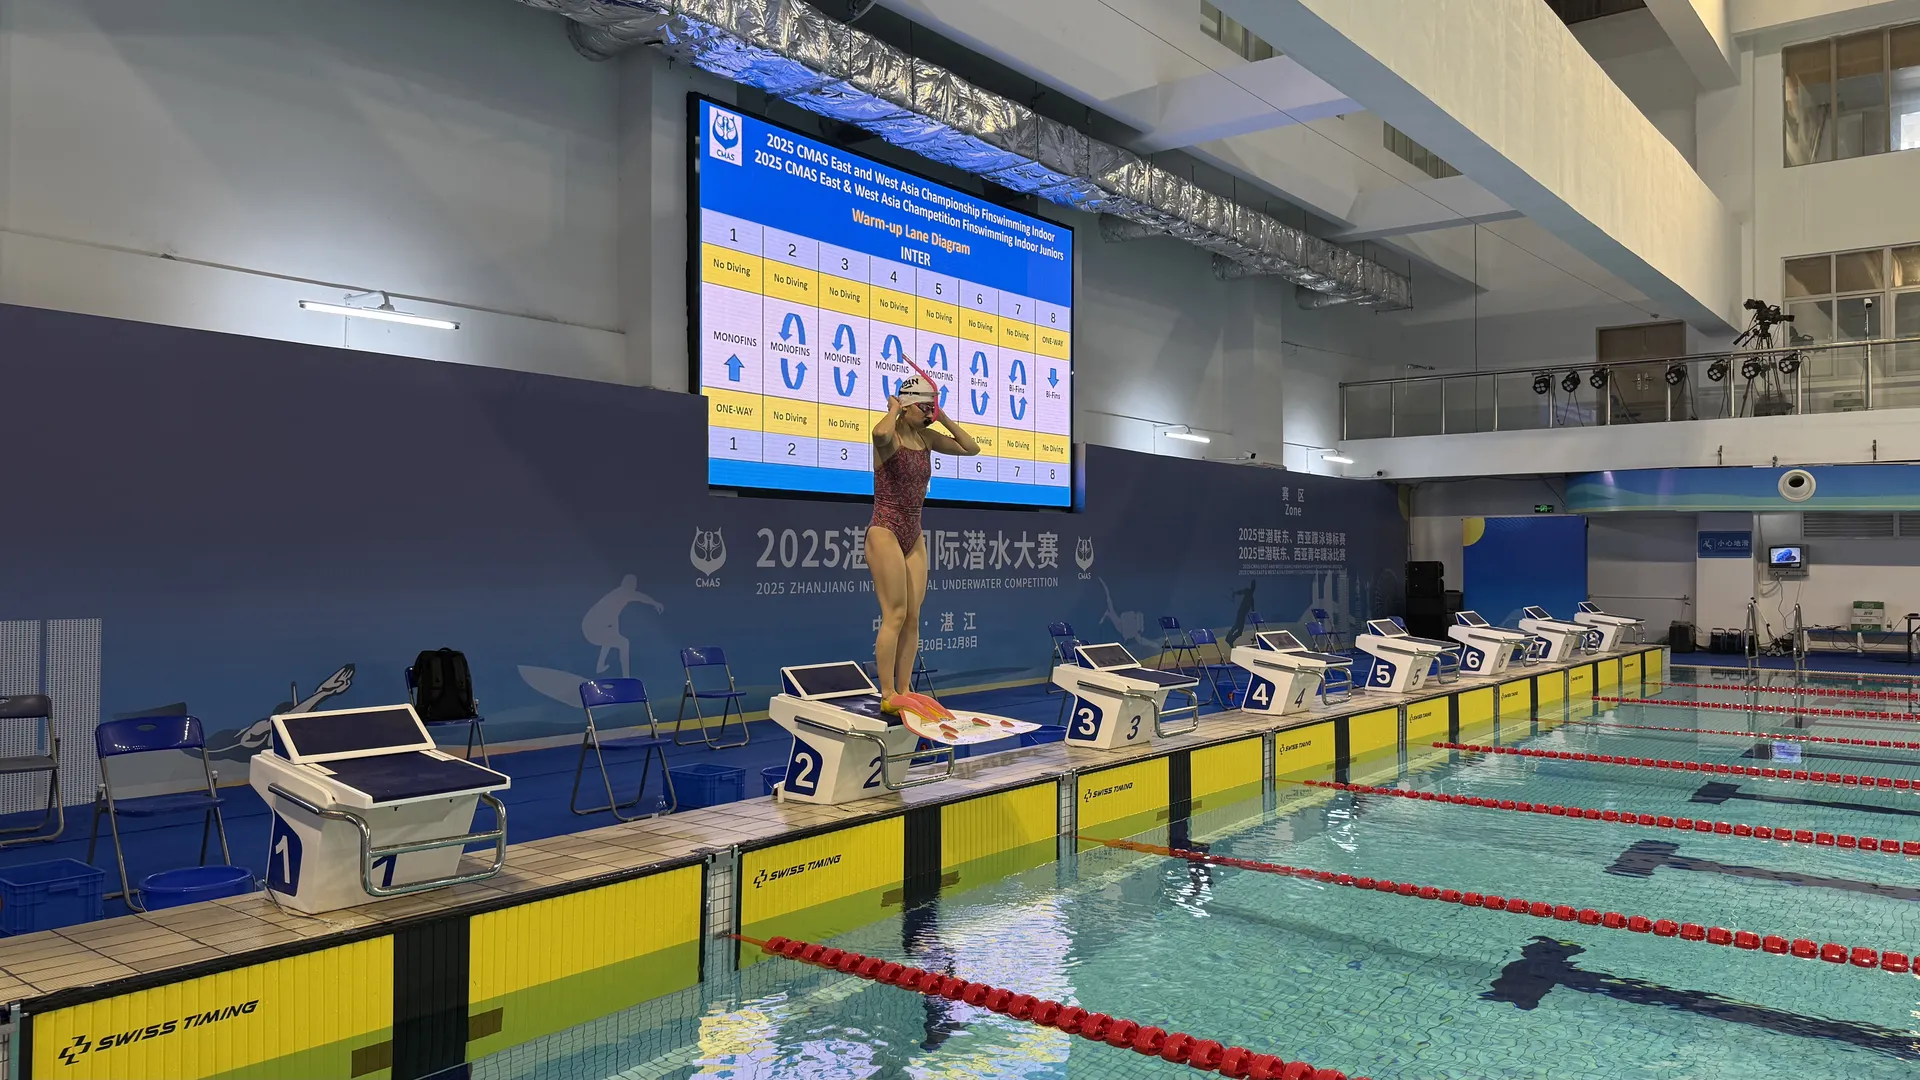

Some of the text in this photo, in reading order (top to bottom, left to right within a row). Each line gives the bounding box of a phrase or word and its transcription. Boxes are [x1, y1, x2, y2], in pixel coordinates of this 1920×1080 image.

[716, 149, 735, 161] CMAS
[766, 133, 1056, 243] 2025 CMAS East and West Asia Championship Finswimming Indoor
[754, 150, 1065, 261] 2025 CMAS East & West Asia Champetition Finswimming Indoor Juniors
[730, 228, 738, 242] 1
[852, 207, 971, 256] Warm-up Lane Diagram
[788, 243, 797, 257] 2
[901, 245, 931, 267] INTER
[713, 258, 751, 277] No Diving
[841, 258, 849, 270] 3
[774, 273, 808, 291] No Diving
[890, 271, 898, 283] 4
[829, 286, 861, 303] No Diving
[935, 283, 942, 295] 5
[977, 293, 983, 304] 6
[879, 298, 909, 314] No Diving
[1015, 304, 1021, 315] 7
[926, 309, 952, 324] No Diving
[1050, 312, 1056, 323] 8
[968, 319, 993, 333] No Diving
[713, 331, 757, 347] MONOFINS
[1006, 328, 1030, 341] No Diving
[1041, 336, 1064, 347] ONE-WAY
[770, 341, 810, 357] MONOFINS
[824, 351, 861, 366] MONOFINS
[875, 360, 909, 374] MONOFINS
[971, 377, 988, 388] Bi-Fins
[1009, 384, 1025, 394] Bi-Fins
[1045, 390, 1061, 400] Bi-Fins
[716, 403, 753, 417] ONE-WAY
[773, 411, 808, 425] No Diving
[828, 418, 860, 432] No Diving
[729, 437, 738, 451] 1
[976, 435, 993, 447] Diving
[1016, 441, 1030, 451] Diving
[788, 442, 796, 456] 2
[840, 448, 848, 461] 3
[1050, 445, 1064, 455] Diving
[934, 458, 941, 470] 5
[976, 461, 982, 473] 6
[1015, 466, 1021, 477] 7
[1050, 469, 1055, 480] 8
[1282, 486, 1305, 502] 赛区
[1285, 504, 1302, 516] Zone
[756, 526, 1059, 571] 2025湛际潜水大赛
[695, 578, 721, 588] CMAS
[756, 582, 785, 595] 2025
[790, 580, 855, 595] ZHANJIANG
[942, 578, 1002, 591] UNDERWATER
[1004, 577, 1059, 589] COMPETITION
[1536, 641, 1547, 655] 7
[1466, 651, 1480, 669] 6
[1498, 652, 1506, 668] 6
[1376, 664, 1391, 684] 5
[1411, 668, 1421, 686] 5
[1252, 683, 1268, 706] 4
[1294, 687, 1306, 708] 4
[1078, 707, 1096, 735] 3
[1126, 715, 1141, 740] 3
[795, 752, 814, 789] 2
[863, 756, 882, 789] 2
[1093, 782, 1133, 798] SWISS TIMING
[275, 835, 290, 884] 1
[372, 853, 397, 887] 1
[769, 854, 841, 881] SWISS TIMING
[95, 1000, 259, 1052] SWISS TIMING
